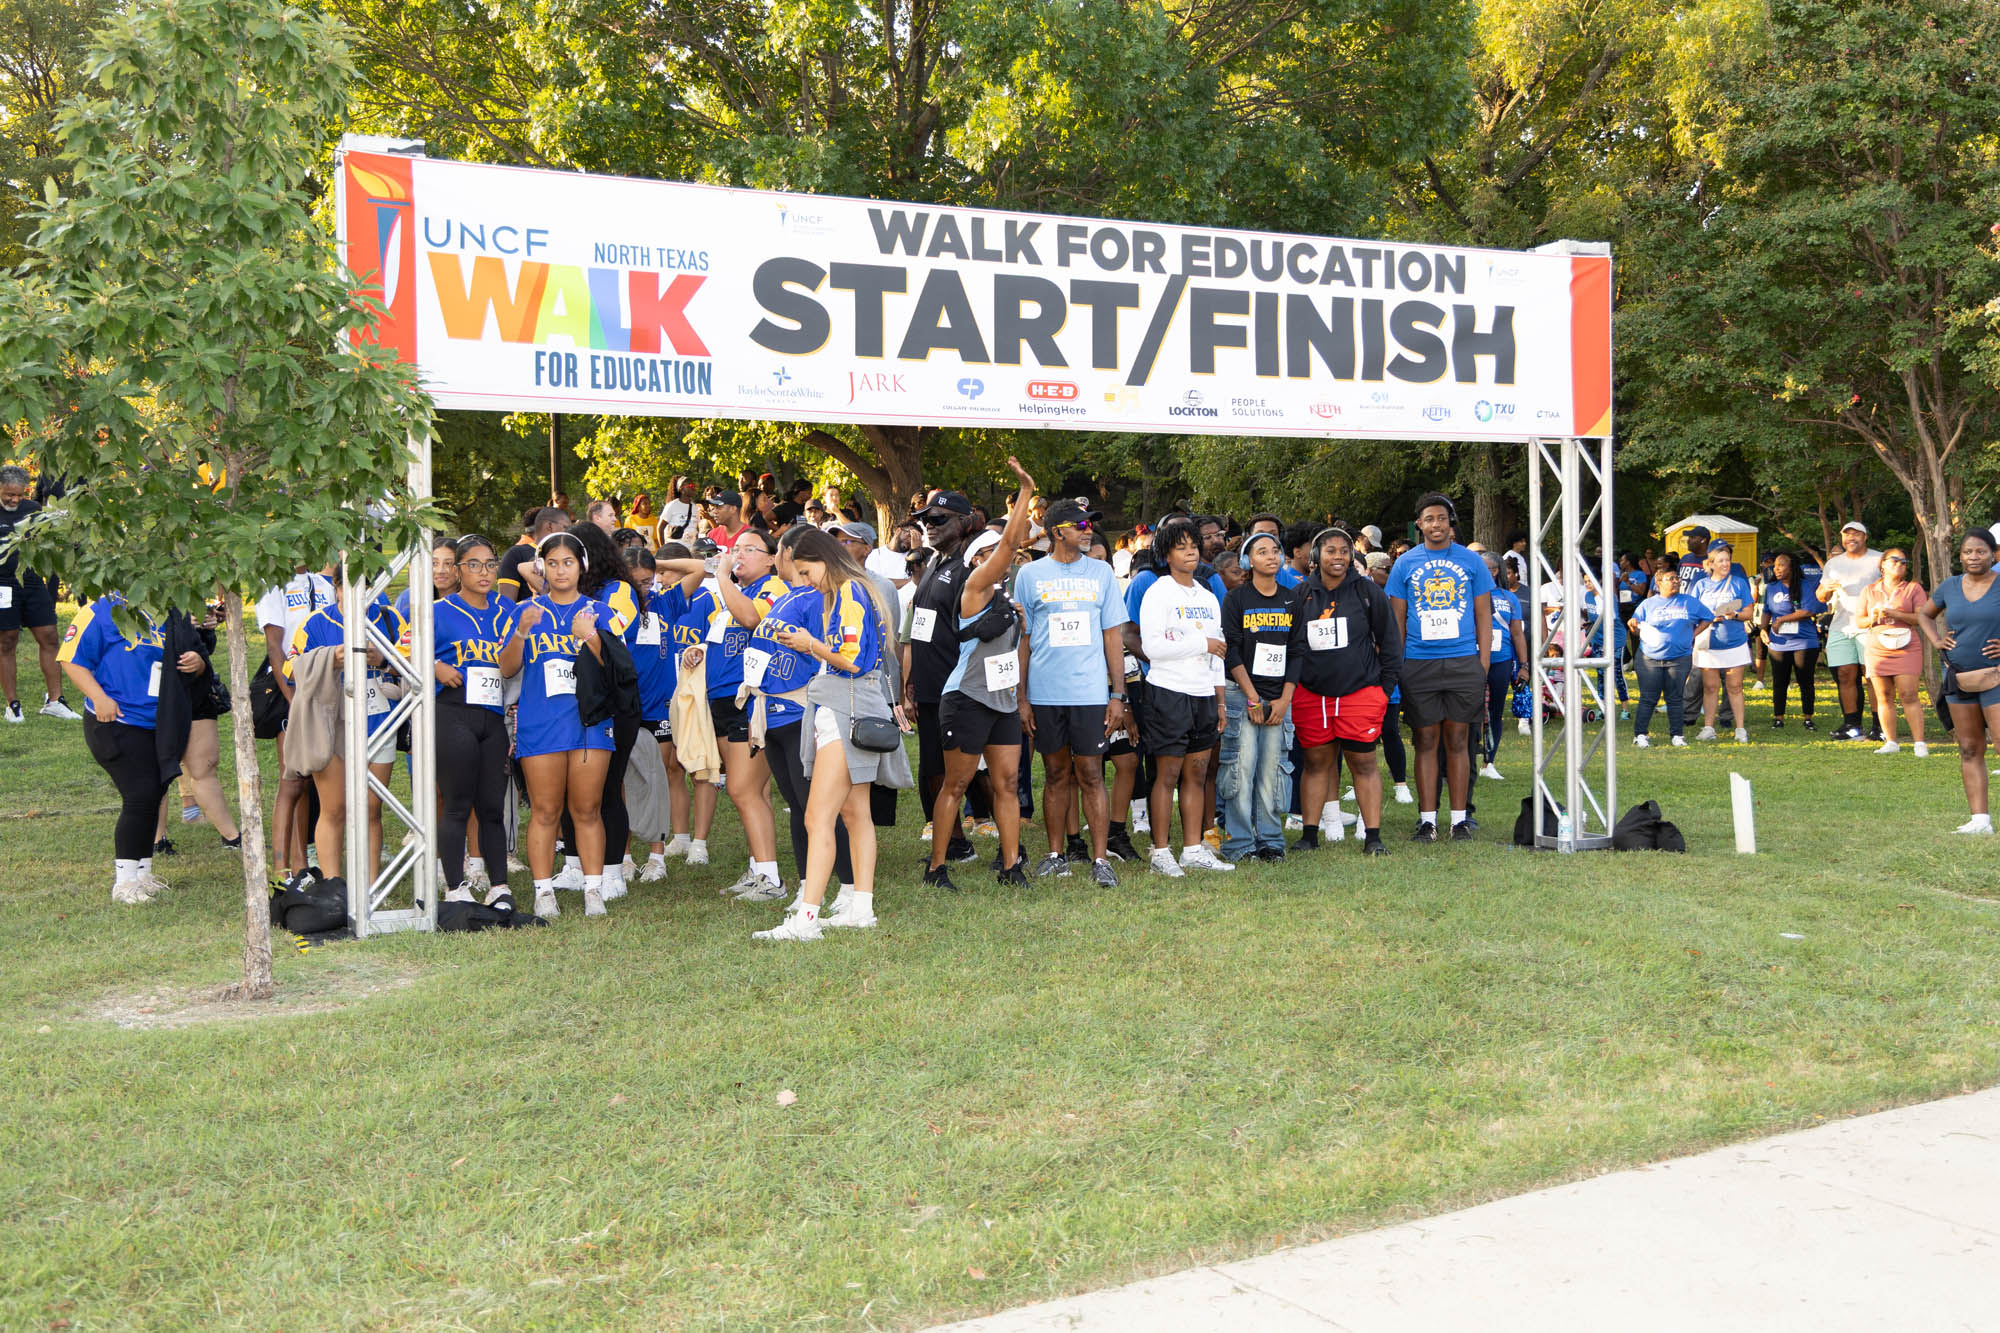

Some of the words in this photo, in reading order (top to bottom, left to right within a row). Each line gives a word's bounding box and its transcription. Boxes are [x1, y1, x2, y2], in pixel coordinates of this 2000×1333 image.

[424, 216, 549, 256] UNCF
[594, 242, 650, 267] NORTH
[656, 247, 709, 271] TEXAS
[867, 208, 1042, 265] WALK
[1057, 225, 1167, 275] FOR
[1181, 234, 1466, 294] EDUCATION
[426, 251, 712, 357] WALK
[748, 257, 1517, 387] START/FINISH
[534, 350, 579, 388] FOR
[590, 355, 712, 395] EDUCATION
[1231, 398, 1266, 408] PEOPLE
[1494, 403, 1516, 415] TXU
[1169, 407, 1218, 417] LOCKTON
[1231, 408, 1285, 417] SOLUTIONS
[1422, 407, 1451, 418] KEITH
[1424, 559, 1469, 581] STUDENT
[1060, 621, 1080, 631] 167
[1431, 617, 1448, 627] 104
[1318, 626, 1337, 636] 316
[745, 656, 759, 669] 272
[767, 649, 797, 681] 40
[997, 661, 1014, 674] 345
[481, 677, 500, 689] 270
